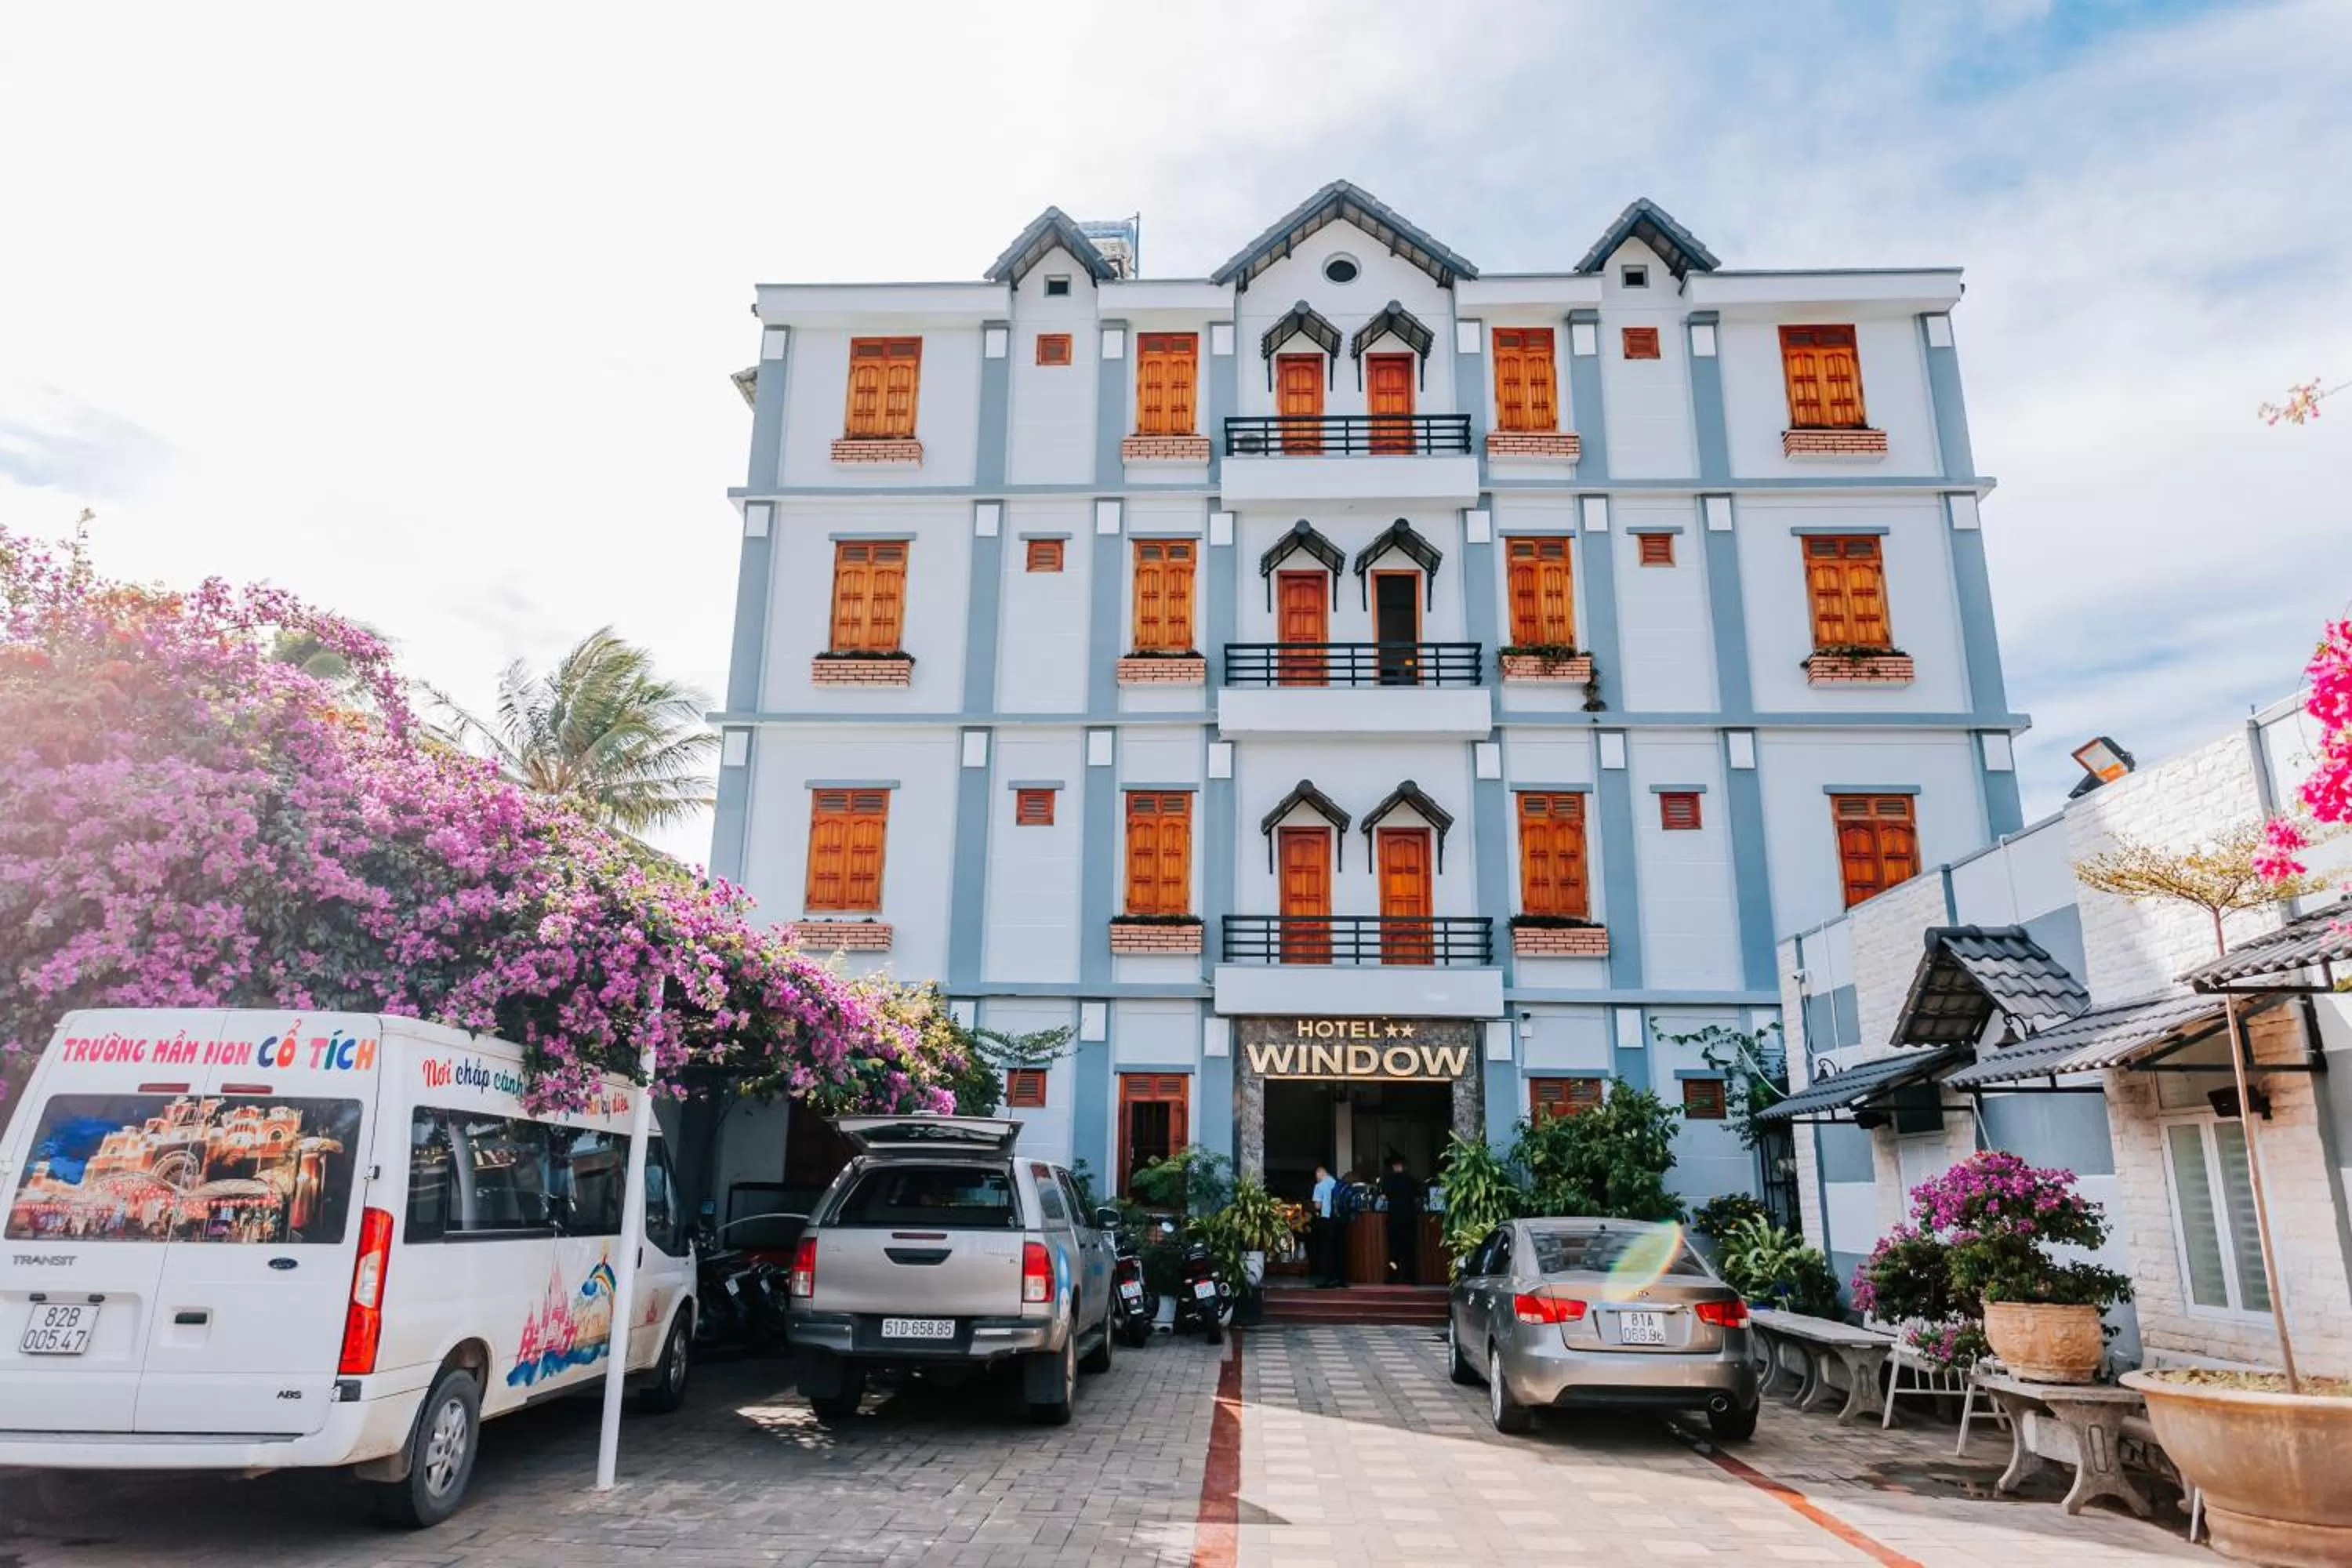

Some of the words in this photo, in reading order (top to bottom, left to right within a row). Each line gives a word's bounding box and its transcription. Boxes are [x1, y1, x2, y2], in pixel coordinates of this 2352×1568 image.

[1298, 1020, 1380, 1039] HOTEL
[63, 1032, 147, 1062] TRƯỜNG
[152, 1029, 198, 1064] MẦM
[203, 1040, 252, 1065] NON
[257, 1018, 302, 1068] CỔ
[310, 1029, 376, 1070] TÍCH
[1247, 1044, 1470, 1076] WINDOW
[423, 1058, 452, 1087] Nơi
[13, 1254, 78, 1267] TRANSIT
[45, 1307, 81, 1327] 82B
[1632, 1313, 1654, 1327] 81A
[23, 1329, 87, 1350] 005.47
[277, 1391, 302, 1399] ABS
